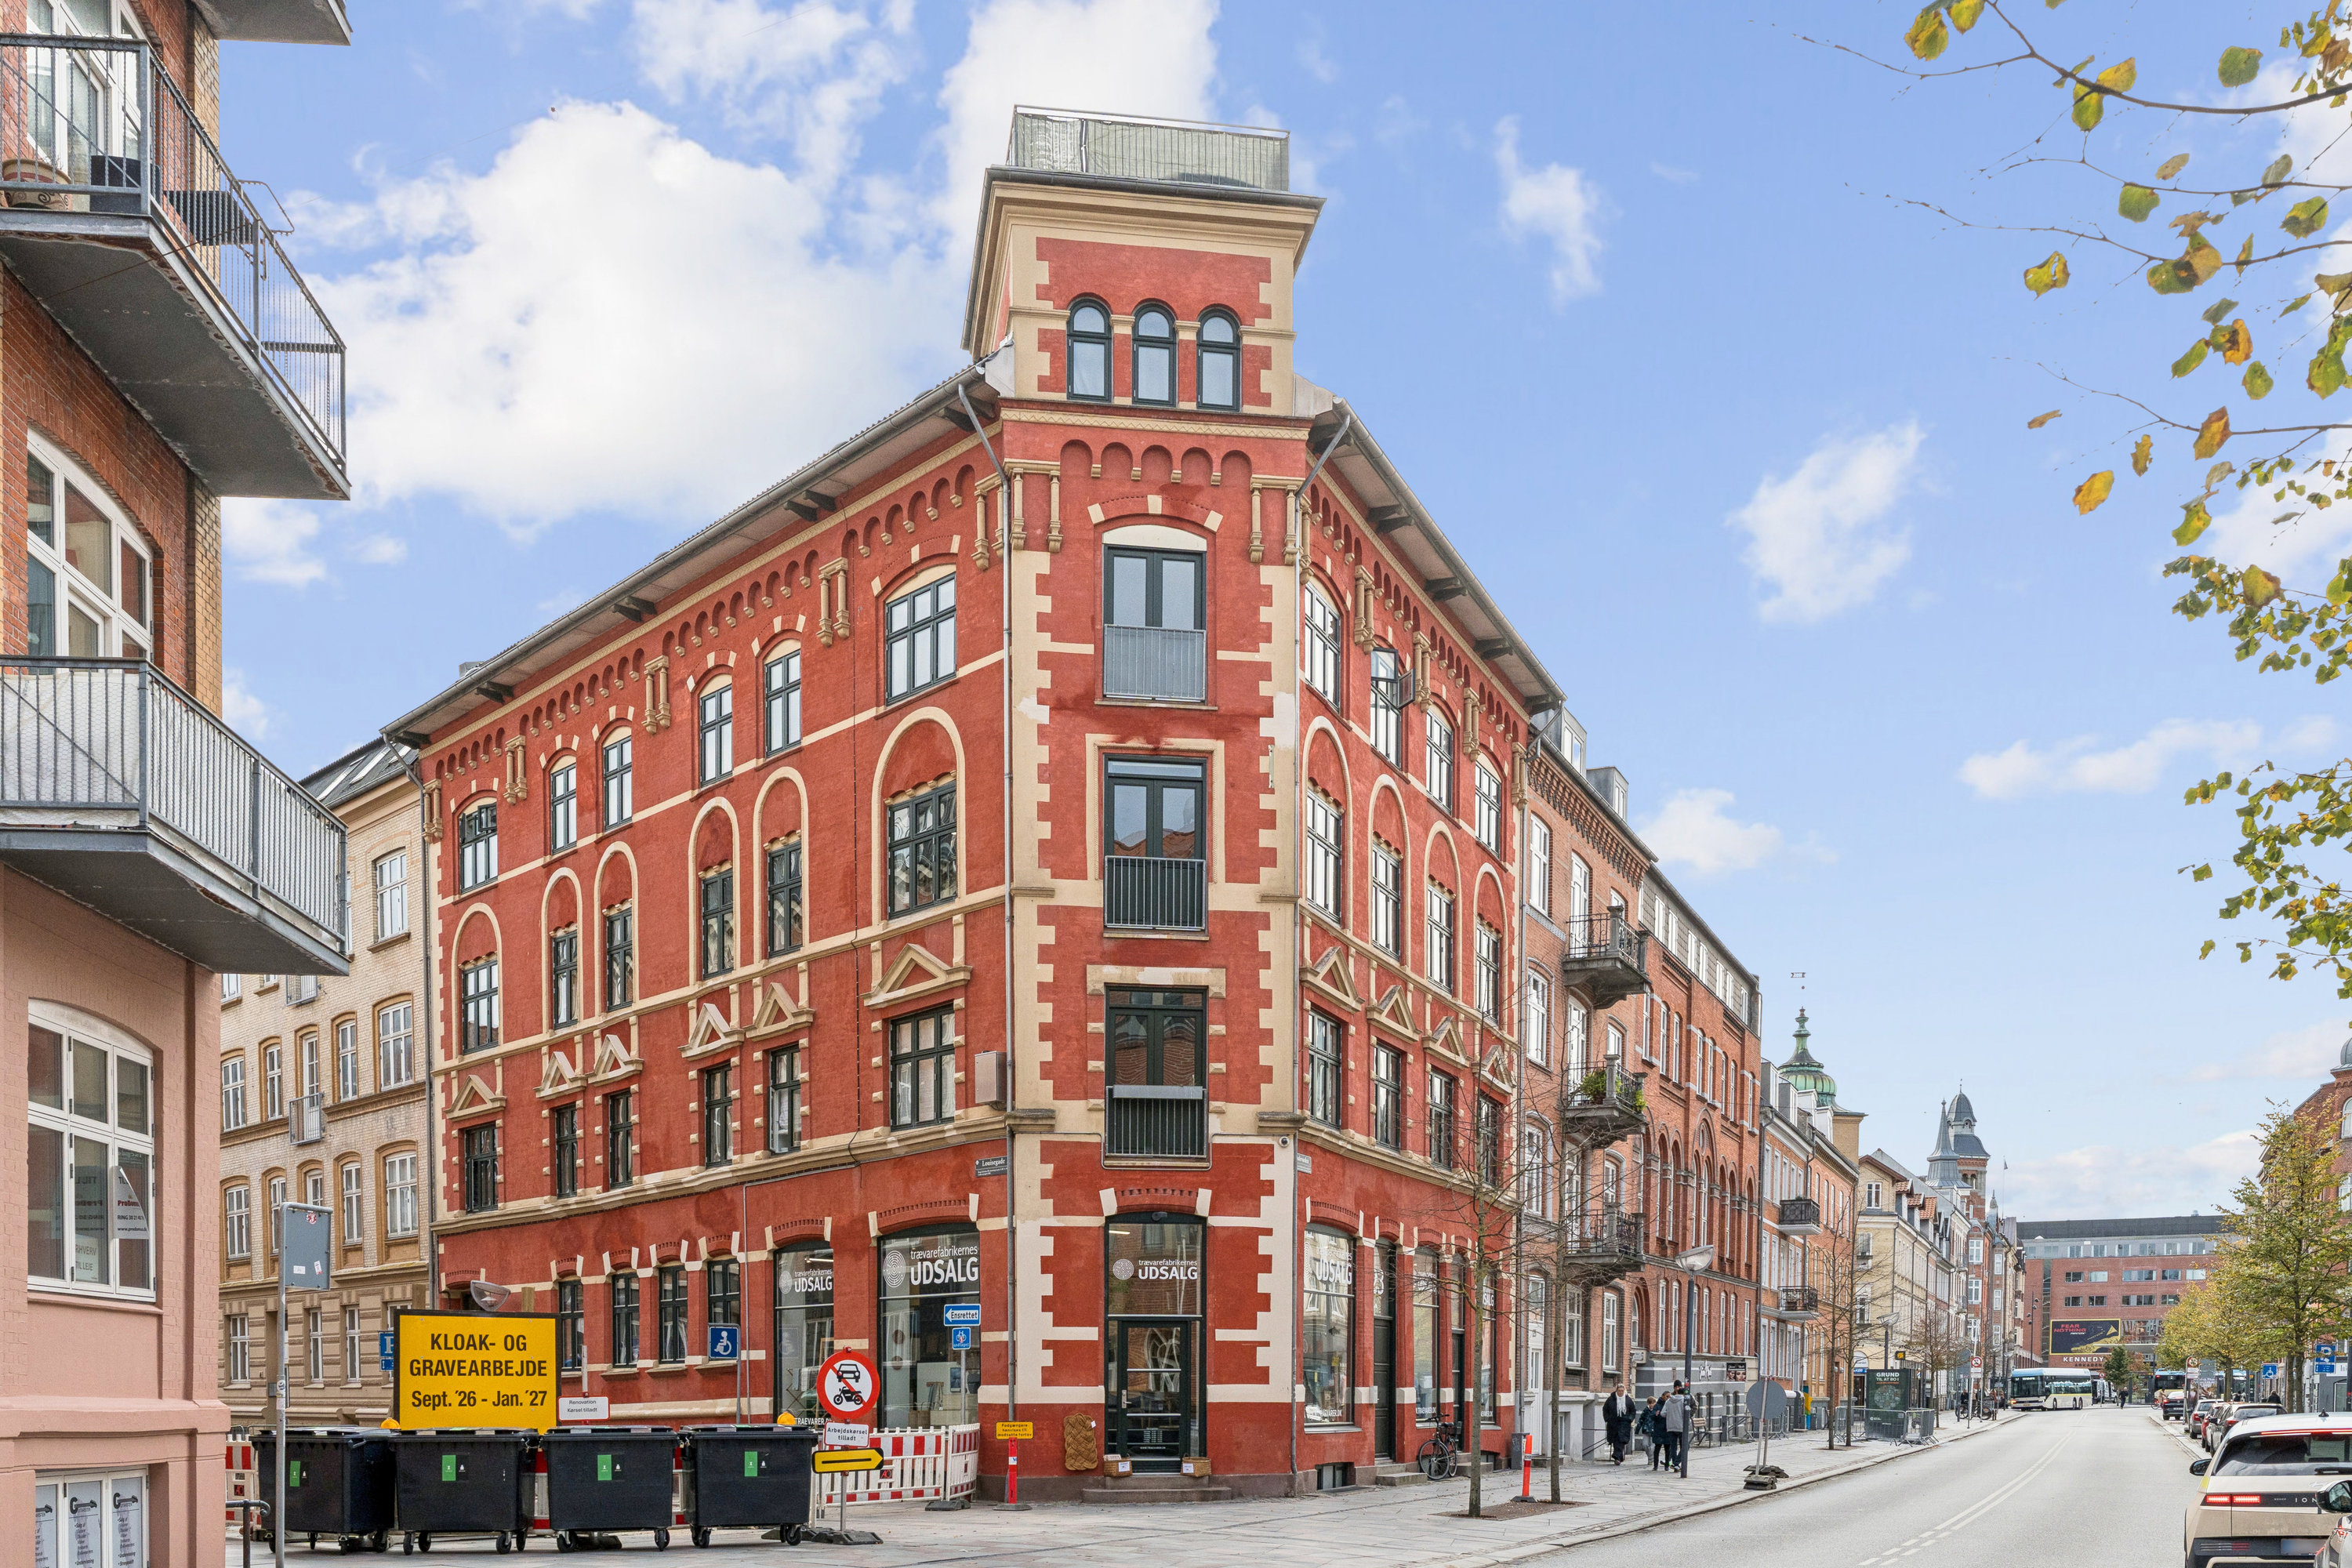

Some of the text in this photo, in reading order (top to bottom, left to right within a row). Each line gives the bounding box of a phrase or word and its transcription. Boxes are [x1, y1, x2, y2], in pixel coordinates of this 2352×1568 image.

[982, 1157, 1005, 1167] Louisegade
[75, 1244, 97, 1256] RHVERV
[910, 1245, 978, 1260] trævarefabrikernes
[794, 1269, 833, 1277] trævarefabrikernes
[910, 1257, 978, 1286] UDSALG
[1138, 1266, 1198, 1279] UDSALG
[1316, 1258, 1352, 1285] UDSALG
[794, 1276, 833, 1293] UDSALG
[950, 1311, 978, 1319] Ensrettet
[430, 1333, 527, 1351] KLOAK- OG
[409, 1359, 547, 1377] GRAVEARBEJDE
[412, 1390, 452, 1411] Sept.
[492, 1390, 523, 1407] Jan.
